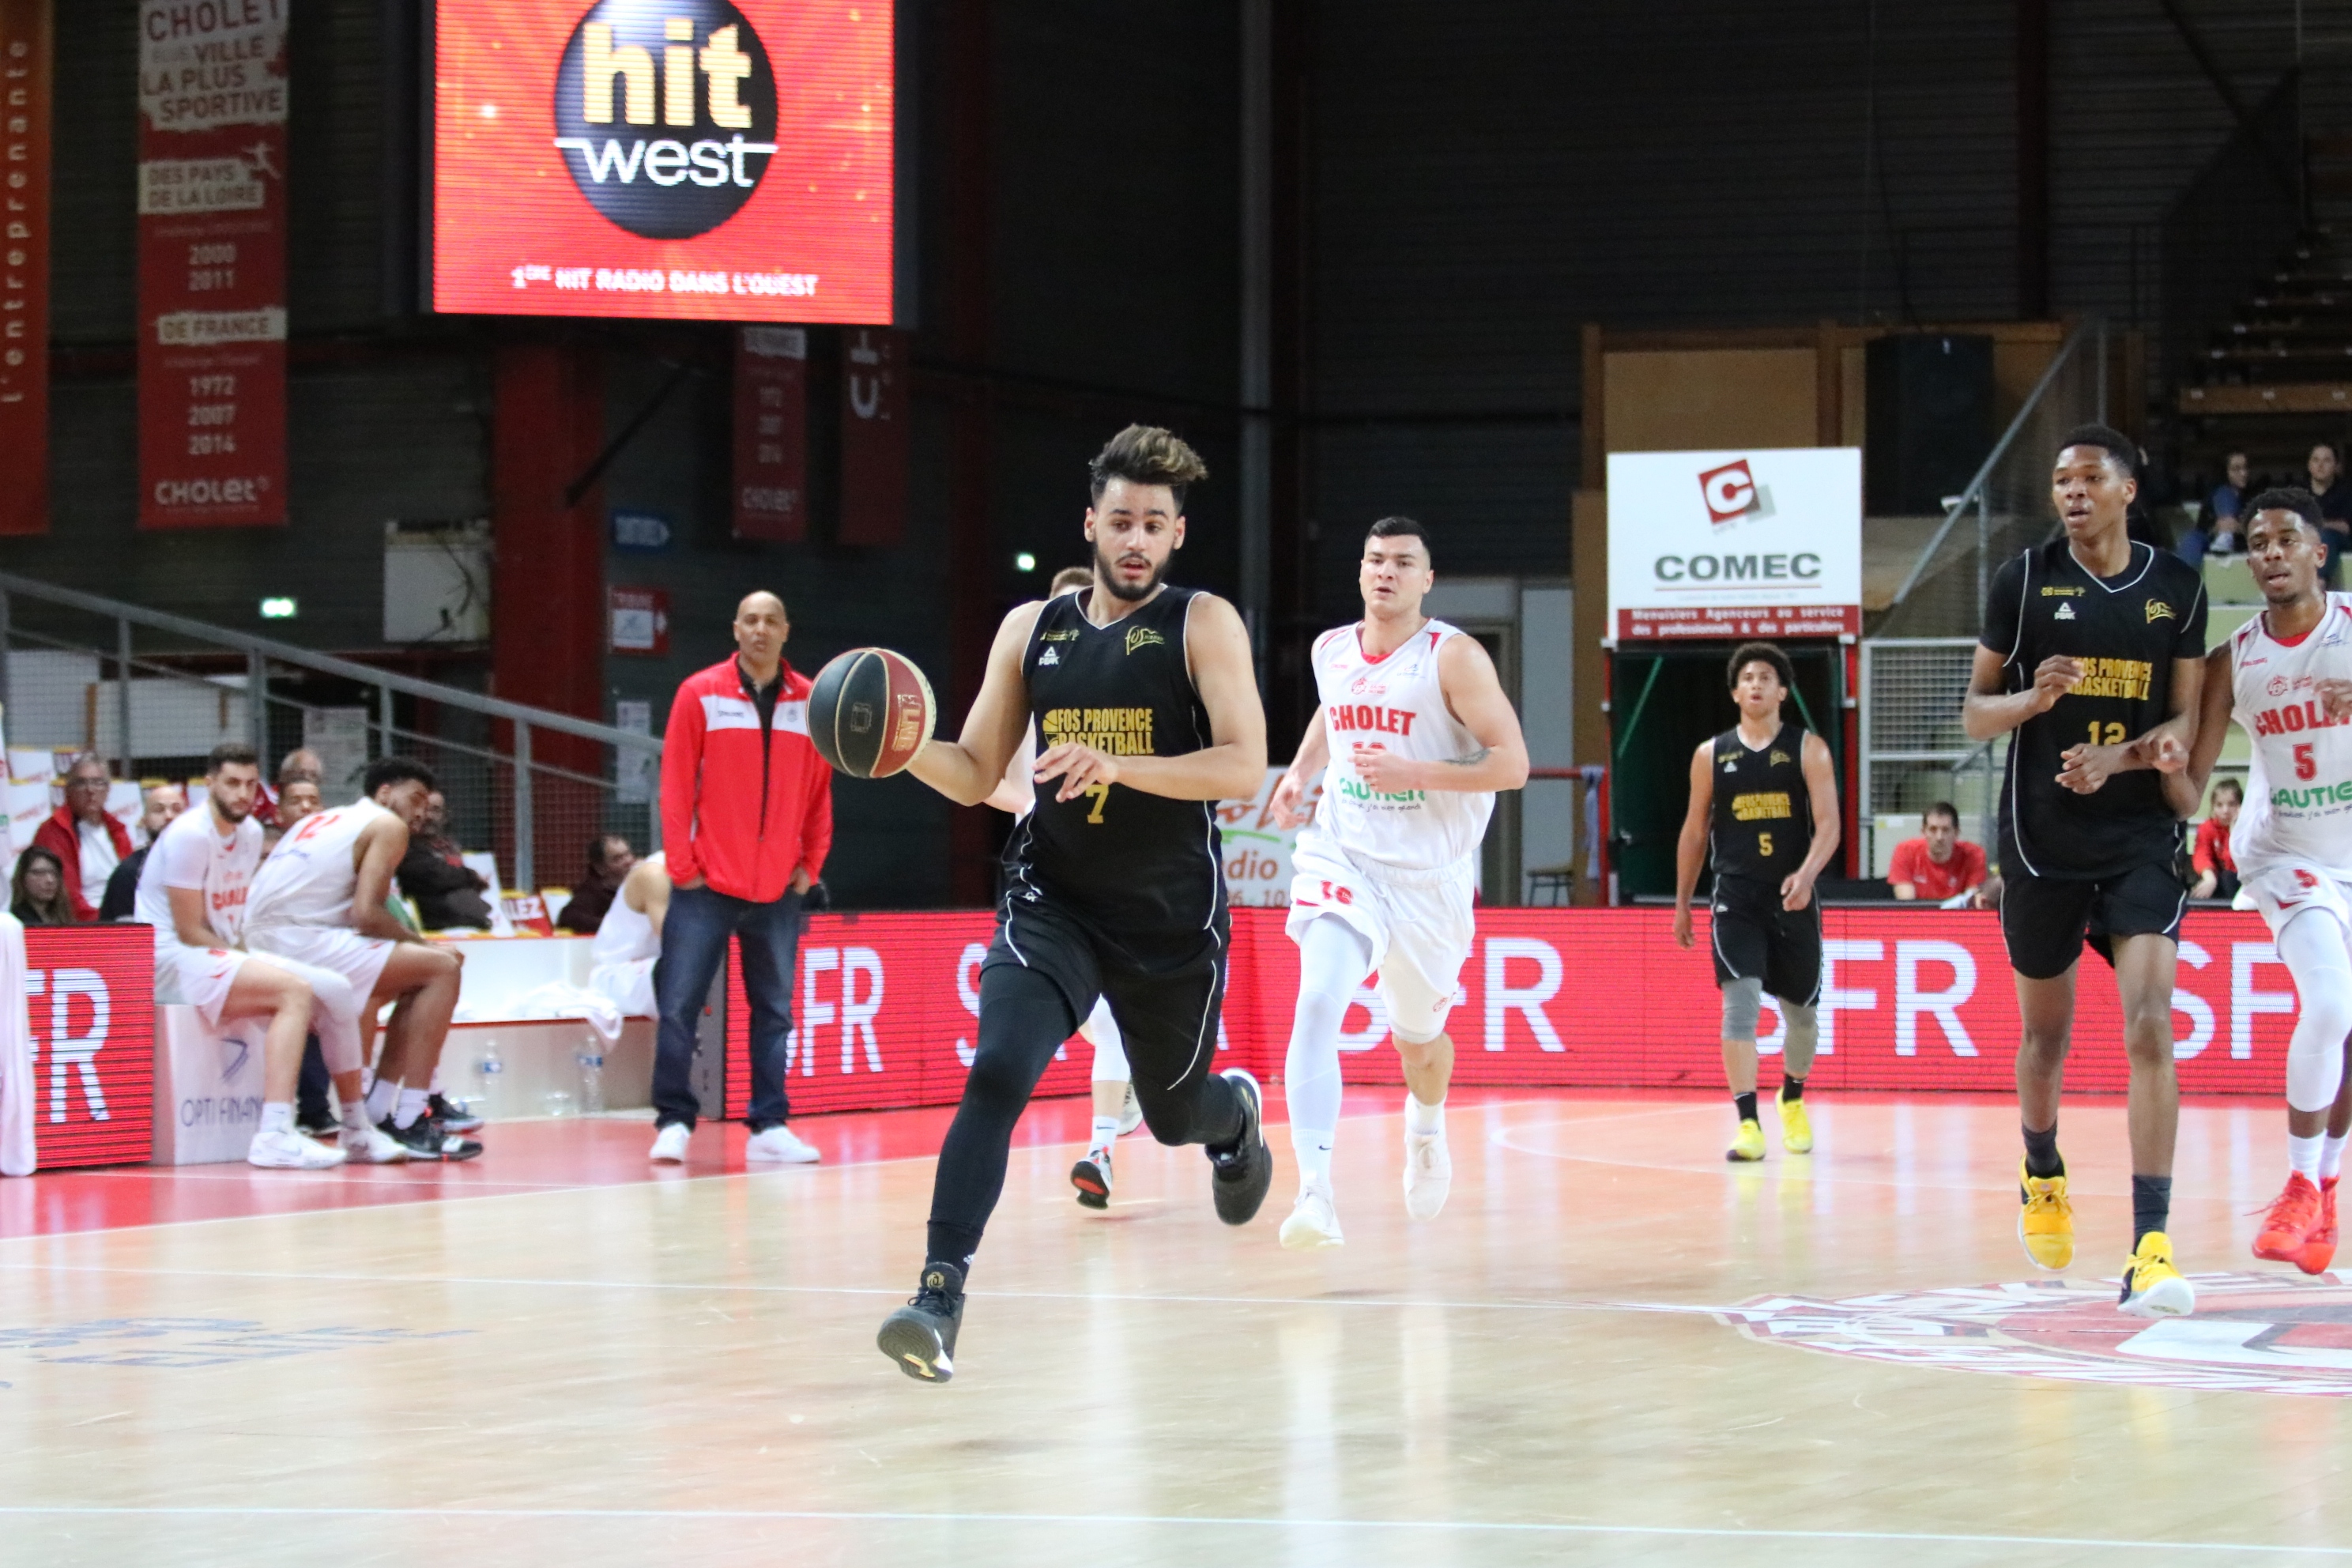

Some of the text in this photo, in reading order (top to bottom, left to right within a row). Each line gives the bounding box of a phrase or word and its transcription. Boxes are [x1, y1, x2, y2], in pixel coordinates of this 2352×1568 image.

[194, 34, 264, 64] VILLE
[141, 63, 246, 96] LA PLUS
[582, 18, 752, 129] hit
[161, 87, 281, 122] SPORTIVE
[555, 134, 778, 187] west
[555, 266, 592, 291] HIT
[595, 267, 665, 293] RADIO
[669, 270, 729, 295] DANS
[1653, 552, 1822, 582] COMEC
[1800, 606, 1844, 618] service
[1038, 655, 1060, 666] PEAK
[2098, 658, 2152, 681] PROVENCE
[1057, 708, 1153, 732] FOS PROVENCE
[1329, 704, 1417, 736] CHOLET
[2087, 721, 2127, 746] 12
[2255, 701, 2350, 737] CHOL
[2292, 743, 2317, 782] 5
[1085, 783, 1109, 824] 7
[2271, 781, 2352, 808] AUTIE
[1758, 832, 1773, 857] 5
[1221, 850, 1279, 880] dio
[786, 947, 884, 1076] FR
[2172, 940, 2295, 1060] SF
